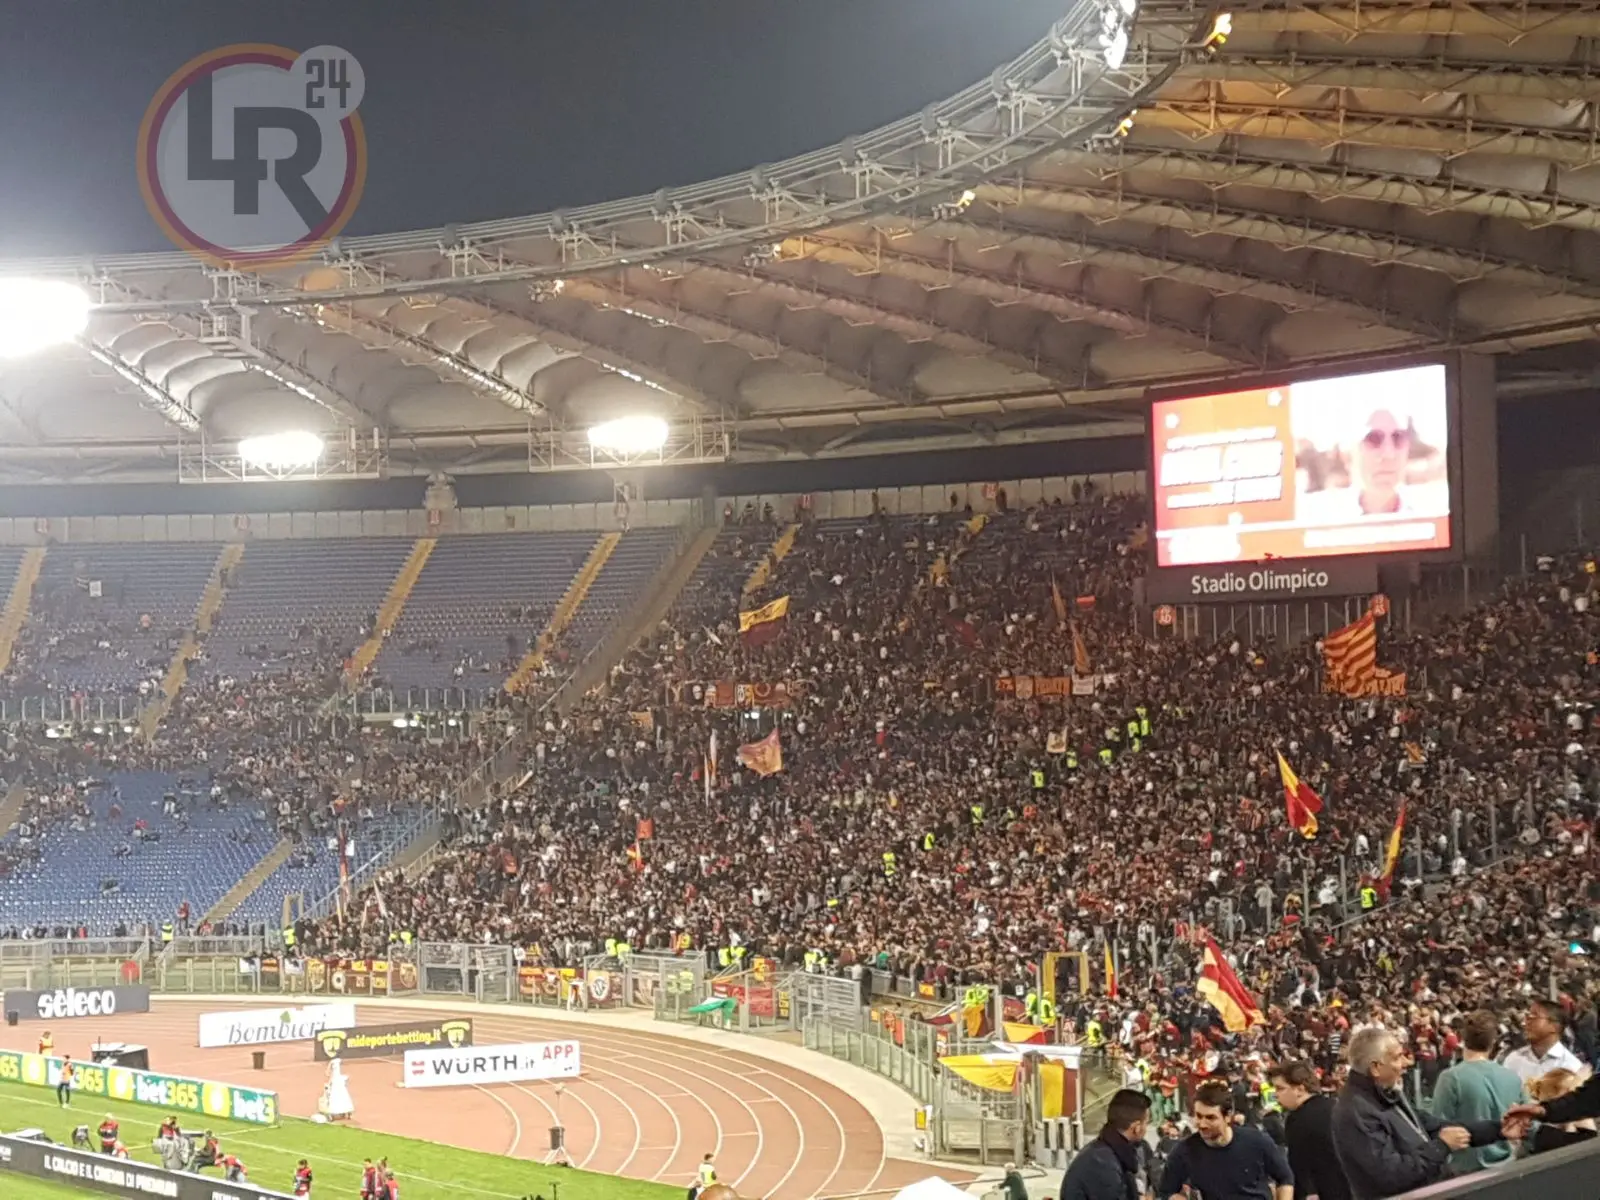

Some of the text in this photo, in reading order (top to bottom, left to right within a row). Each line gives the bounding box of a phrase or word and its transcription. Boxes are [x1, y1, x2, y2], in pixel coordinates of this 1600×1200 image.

[1191, 568, 1329, 594] Stadio Olimpico
[543, 1044, 574, 1060] APP
[136, 1074, 199, 1109] bet365
